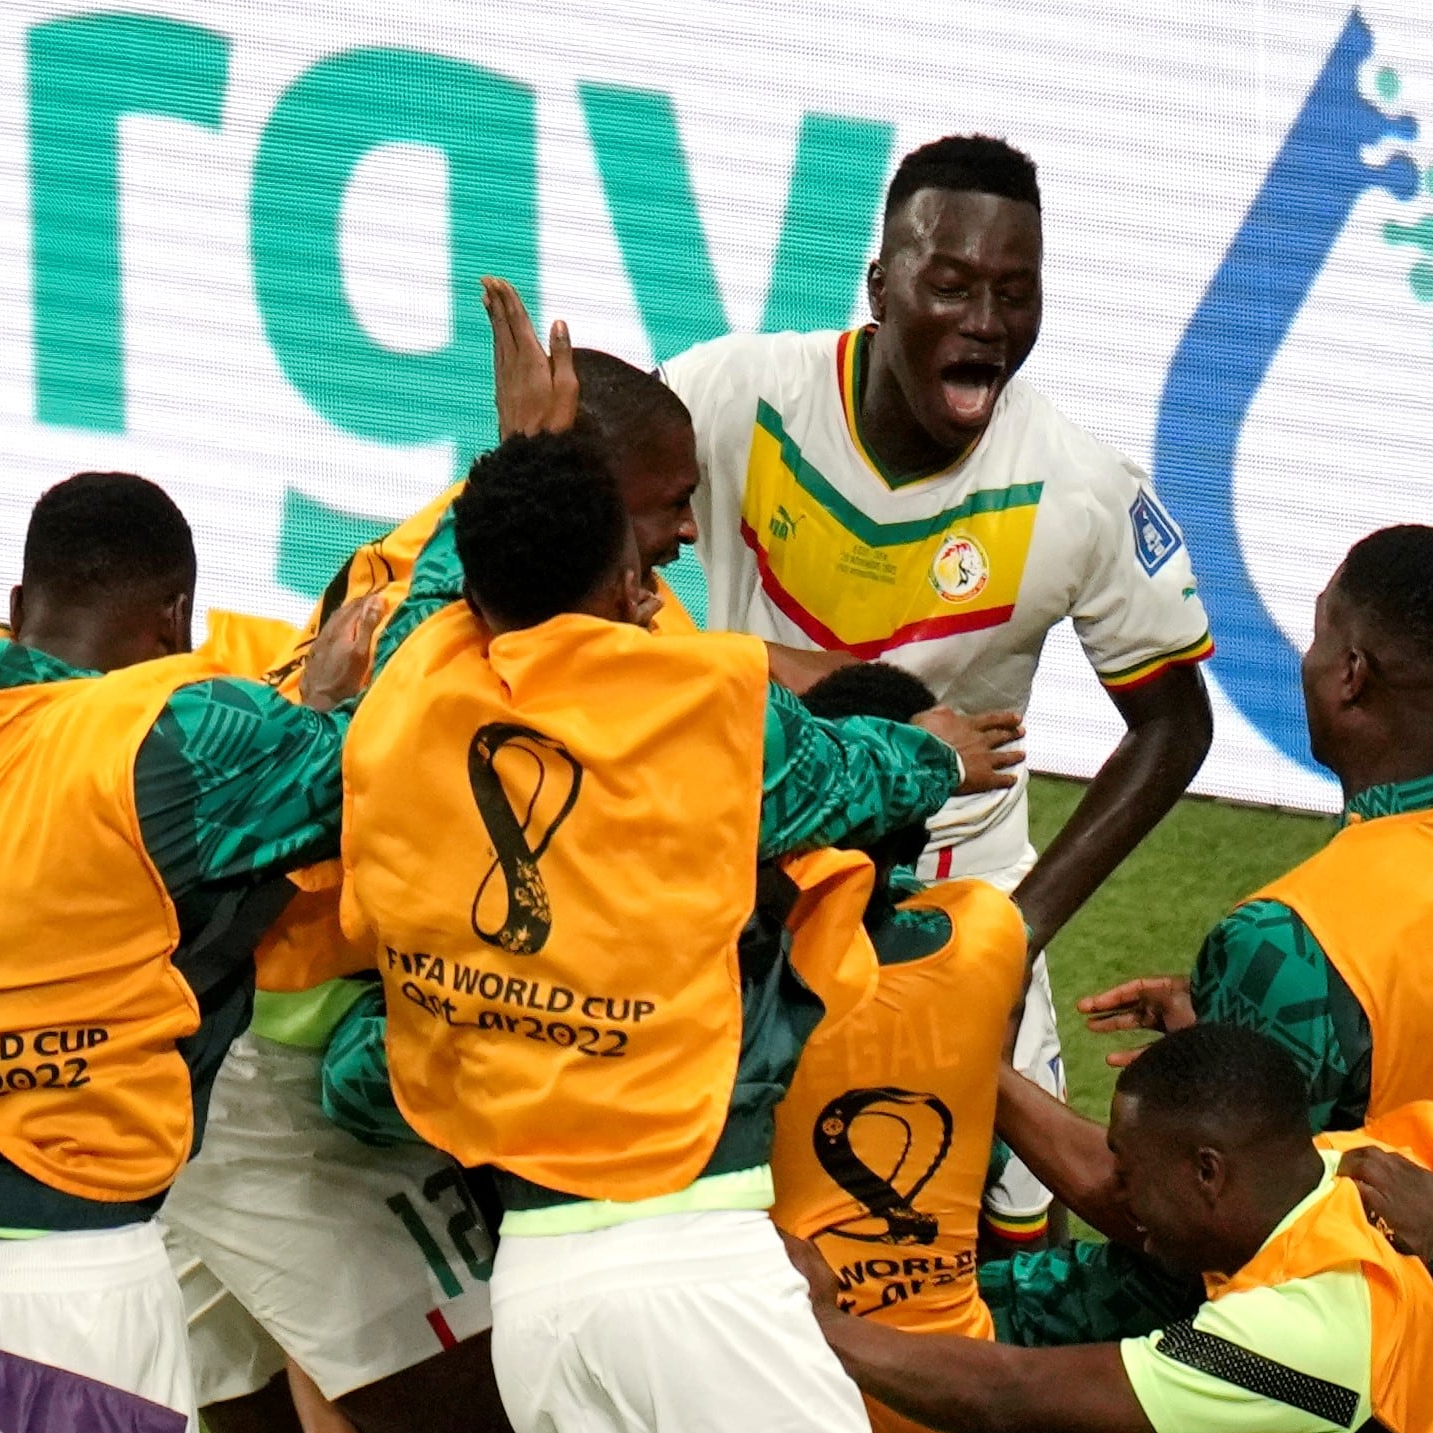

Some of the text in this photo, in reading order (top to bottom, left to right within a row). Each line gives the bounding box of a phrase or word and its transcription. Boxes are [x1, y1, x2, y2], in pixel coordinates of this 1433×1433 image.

[386, 945, 655, 1022] FIFA WORLD CUP
[34, 1028, 109, 1056] CUP
